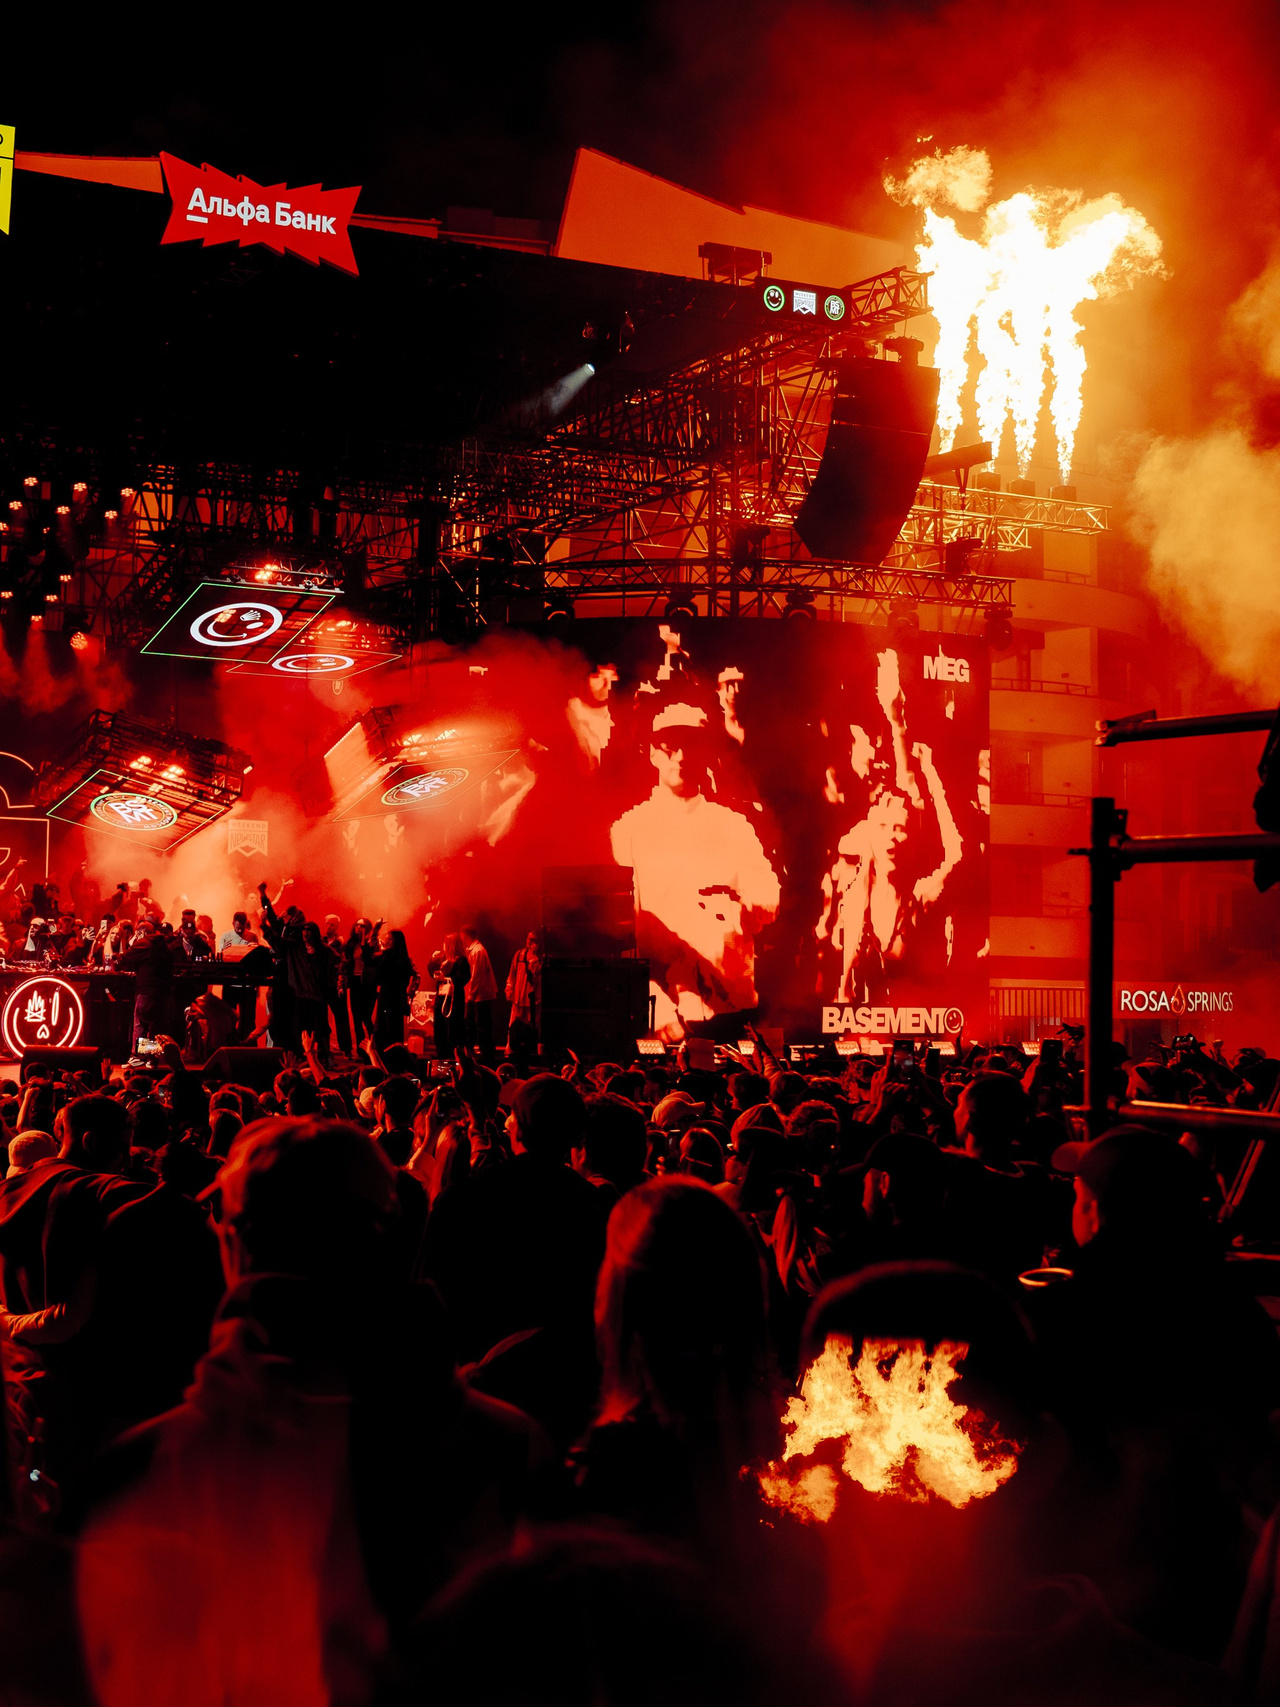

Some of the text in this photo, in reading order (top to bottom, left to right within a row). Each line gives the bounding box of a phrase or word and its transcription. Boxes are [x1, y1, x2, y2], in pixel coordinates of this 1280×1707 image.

[186, 187, 337, 235] Альфа Банк
[923, 655, 970, 683] MEG
[1120, 990, 1233, 1012] ROSA SPRINGS
[822, 1006, 948, 1034] BASEMENT
